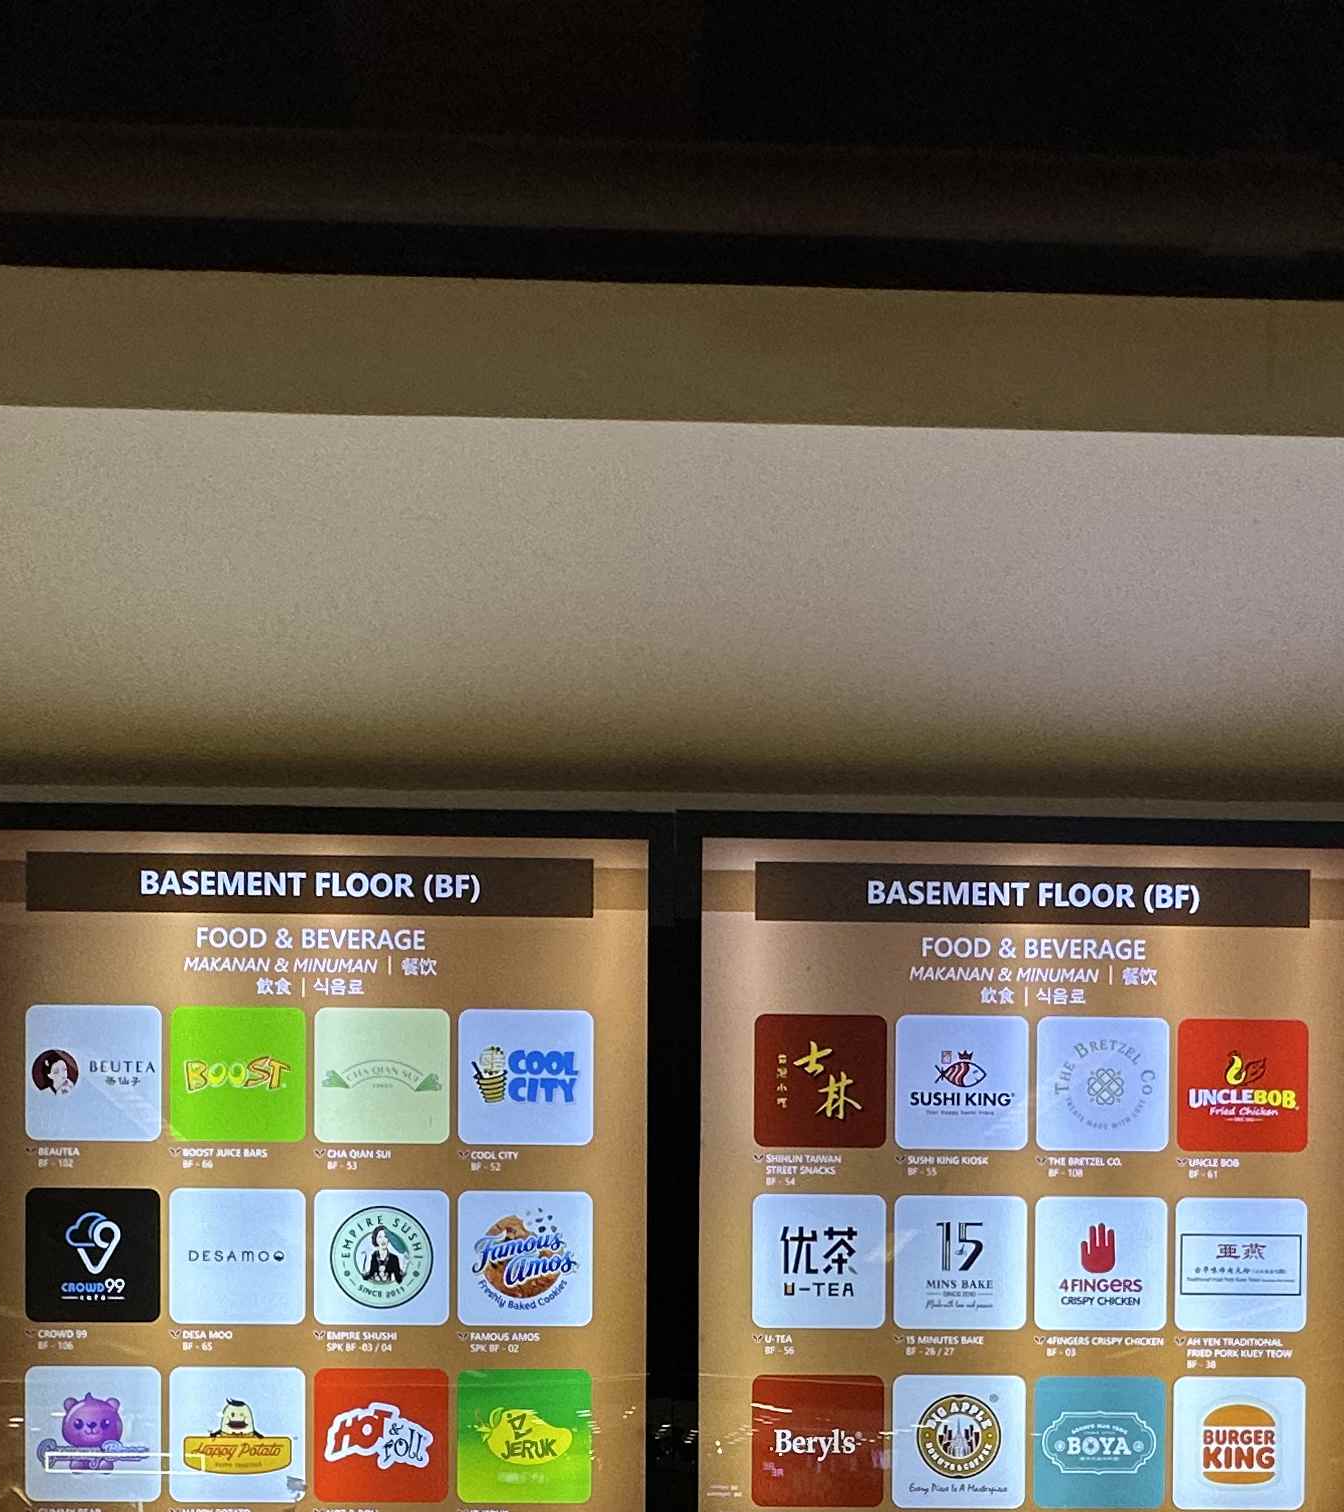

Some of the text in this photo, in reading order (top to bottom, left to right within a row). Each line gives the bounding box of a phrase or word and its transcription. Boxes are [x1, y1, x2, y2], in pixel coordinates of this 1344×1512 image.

[141, 871, 480, 903] BASEMENT FLOOR (BF)
[868, 881, 1200, 914] BASEMENT FLOOR (BF)
[197, 927, 426, 951] FOOD & BEVERAGE
[275, 958, 288, 972] &
[294, 958, 377, 973] MINUMAN
[401, 958, 437, 976] 餐饮
[256, 977, 292, 995] 飲食
[313, 978, 364, 995] 식음료
[90, 1061, 155, 1072] BEUTEA
[505, 1050, 578, 1077] COOL
[183, 1056, 291, 1093] BOOST
[508, 1077, 577, 1102] CITY
[911, 1092, 1010, 1106] SUSHI KING
[1190, 1089, 1296, 1111] UNCLEBOB
[1209, 1106, 1238, 1116] Fried
[182, 1148, 267, 1157] BOOST JUICE BARS
[327, 1149, 391, 1159] CHA QIAN SUI
[471, 1151, 497, 1159] COOL
[766, 1165, 797, 1175] STREET
[1188, 1159, 1239, 1167] UNCLE BOB
[471, 1231, 564, 1274] Famous
[781, 1227, 857, 1274] 优茶
[505, 1250, 579, 1288] Amos
[1097, 1297, 1140, 1305] CHICKEN
[471, 1333, 540, 1342] FAMOUS AMOS
[338, 1415, 384, 1451] HOT
[773, 1428, 855, 1456] Beryl's
[1204, 1430, 1275, 1450] BURGER
[498, 1435, 557, 1462] JERUK
[1067, 1437, 1132, 1456] BOYA
[1203, 1447, 1275, 1469] KING
